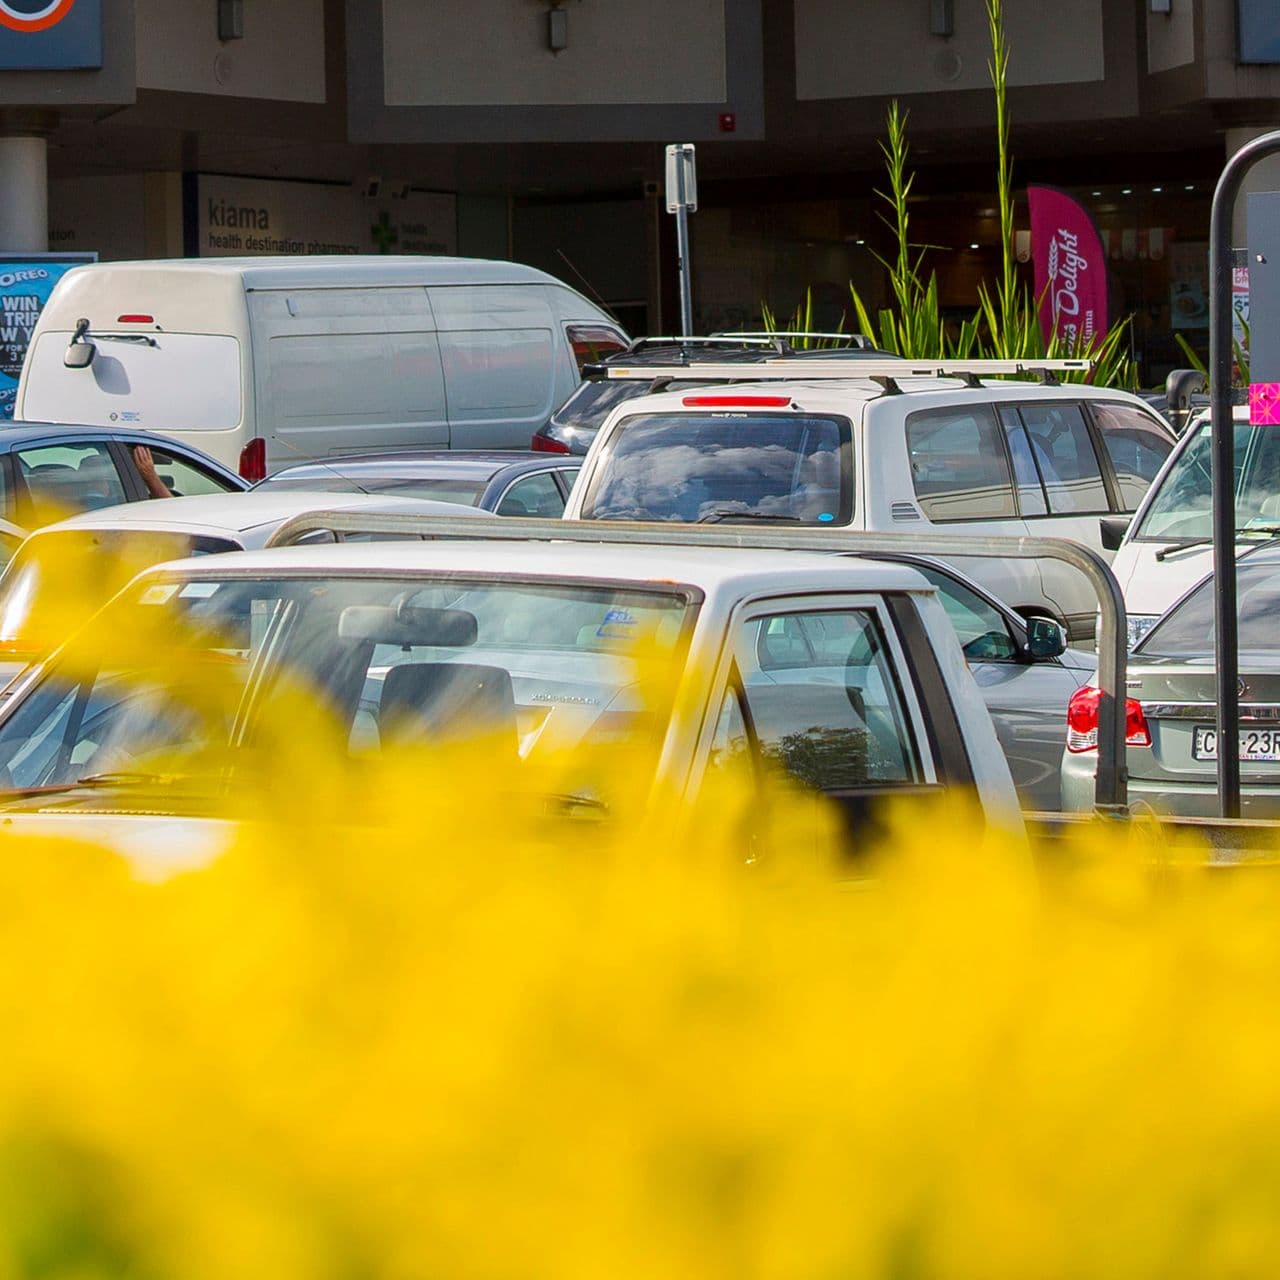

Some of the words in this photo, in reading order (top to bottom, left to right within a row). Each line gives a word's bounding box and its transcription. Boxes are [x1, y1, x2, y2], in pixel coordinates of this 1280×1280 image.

[207, 198, 270, 231] kiama
[208, 233, 243, 251] health
[245, 235, 305, 255] destination
[307, 239, 361, 256] pharmacy
[1056, 228, 1088, 316] Delight
[1, 295, 38, 311] WIN
[10, 351, 18, 361] 3
